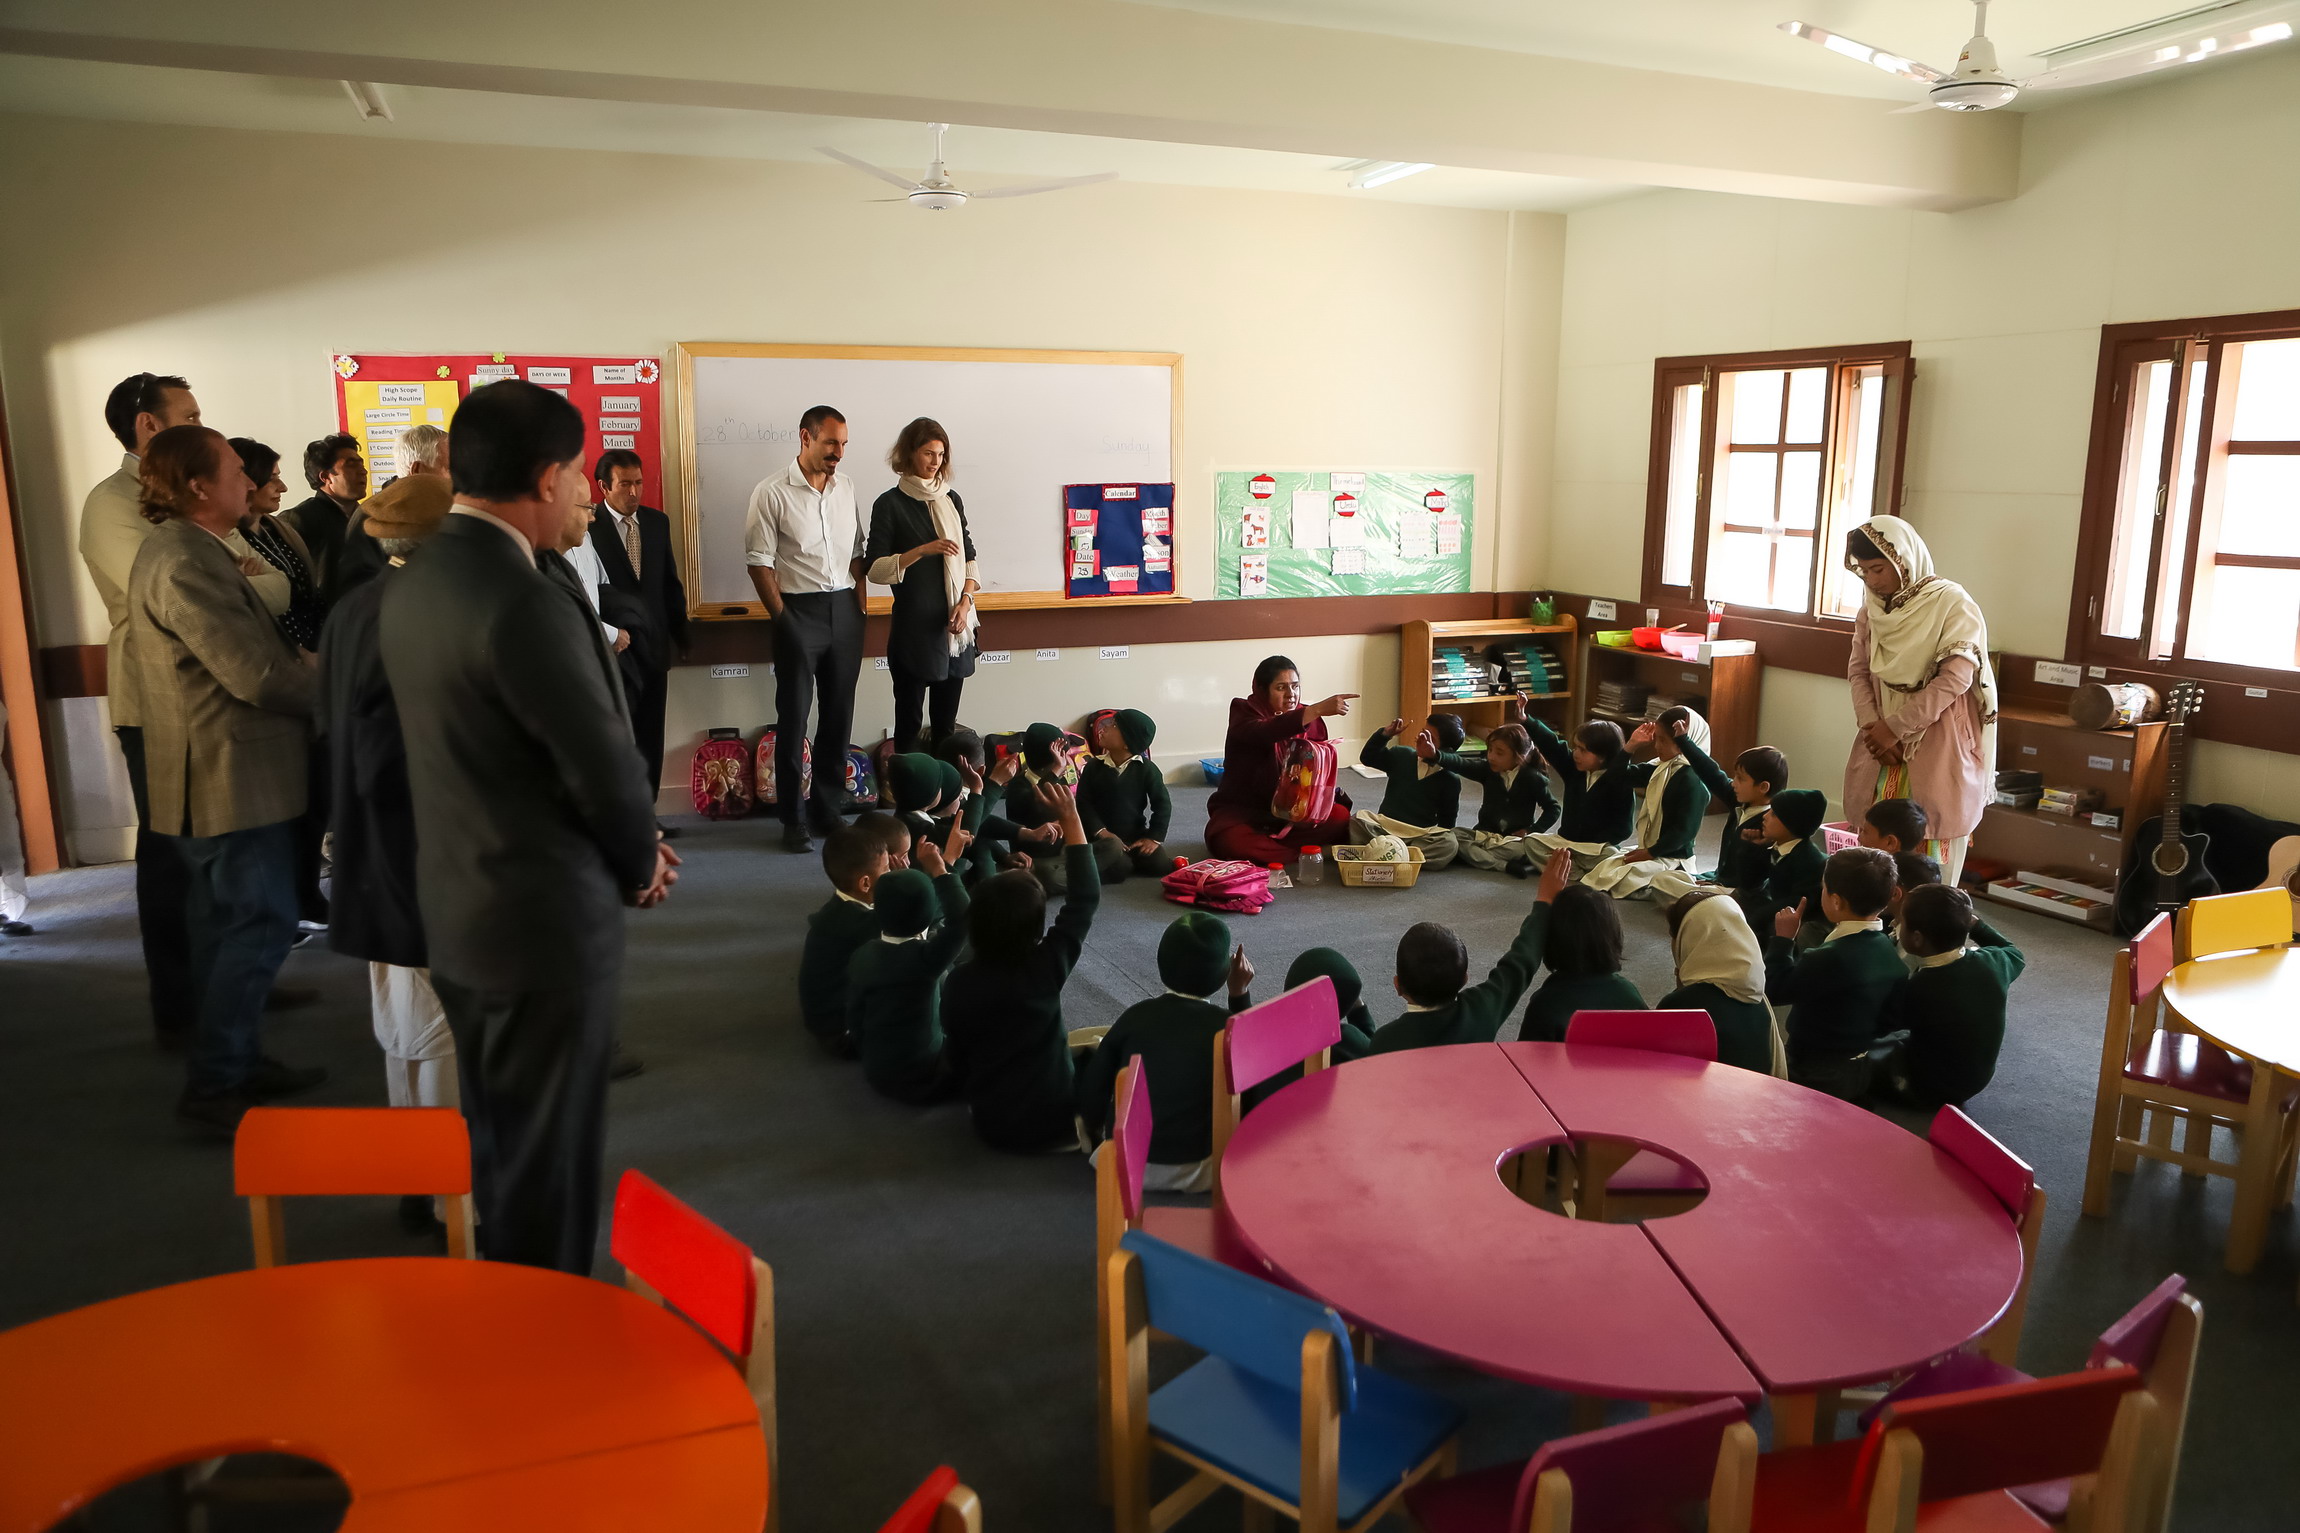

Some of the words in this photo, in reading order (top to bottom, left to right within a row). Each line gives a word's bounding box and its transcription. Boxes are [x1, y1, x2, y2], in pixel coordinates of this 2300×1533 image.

[478, 367, 499, 375] Sunny
[501, 366, 514, 374] day
[602, 400, 639, 412] January
[601, 420, 639, 431] February
[738, 422, 797, 442] October
[604, 438, 634, 447] March
[1102, 435, 1151, 466] Sunday
[1105, 489, 1136, 497] Calendar
[1076, 511, 1089, 520] Day
[980, 653, 1010, 663] Abozar
[1036, 650, 1056, 658] Anita
[1101, 649, 1128, 659] Sayam
[712, 667, 748, 677] Kamran
